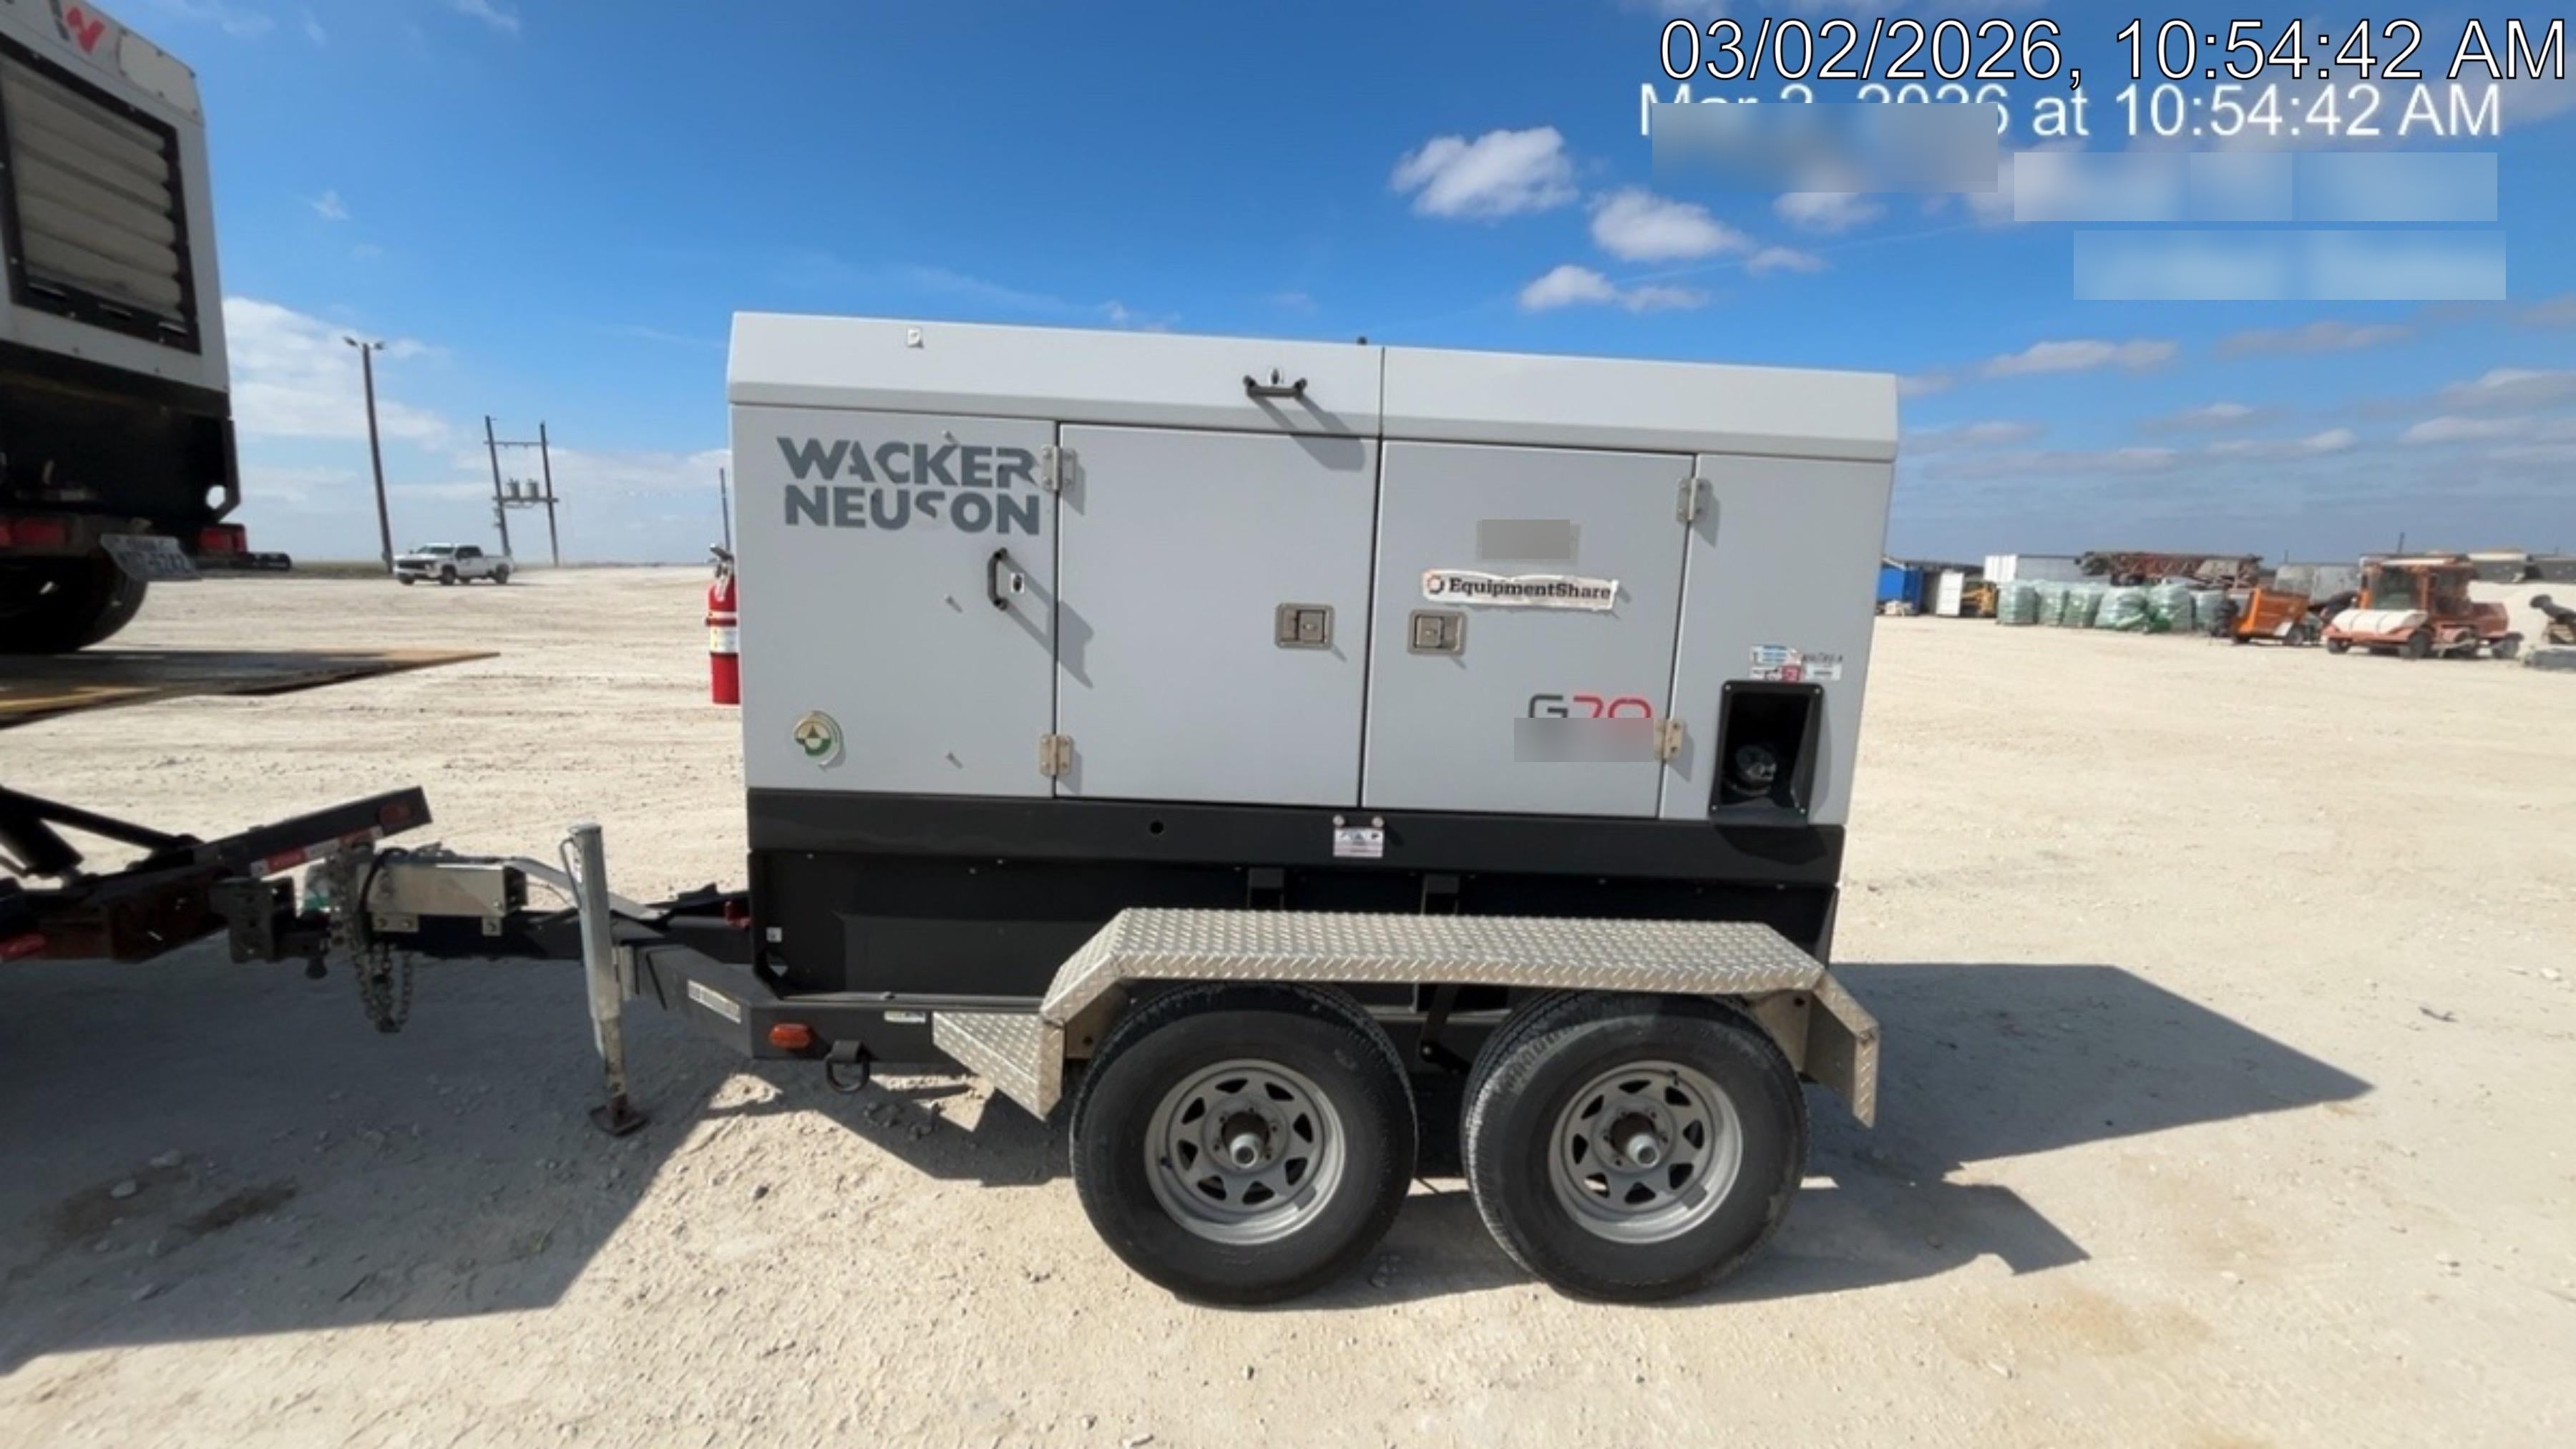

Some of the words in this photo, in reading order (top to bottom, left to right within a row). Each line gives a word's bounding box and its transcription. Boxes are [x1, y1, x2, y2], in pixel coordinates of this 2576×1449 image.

[776, 437, 1040, 488] WACKER
[784, 484, 1040, 535] NEUSON
[1449, 576, 1611, 600] EquipmentShare
